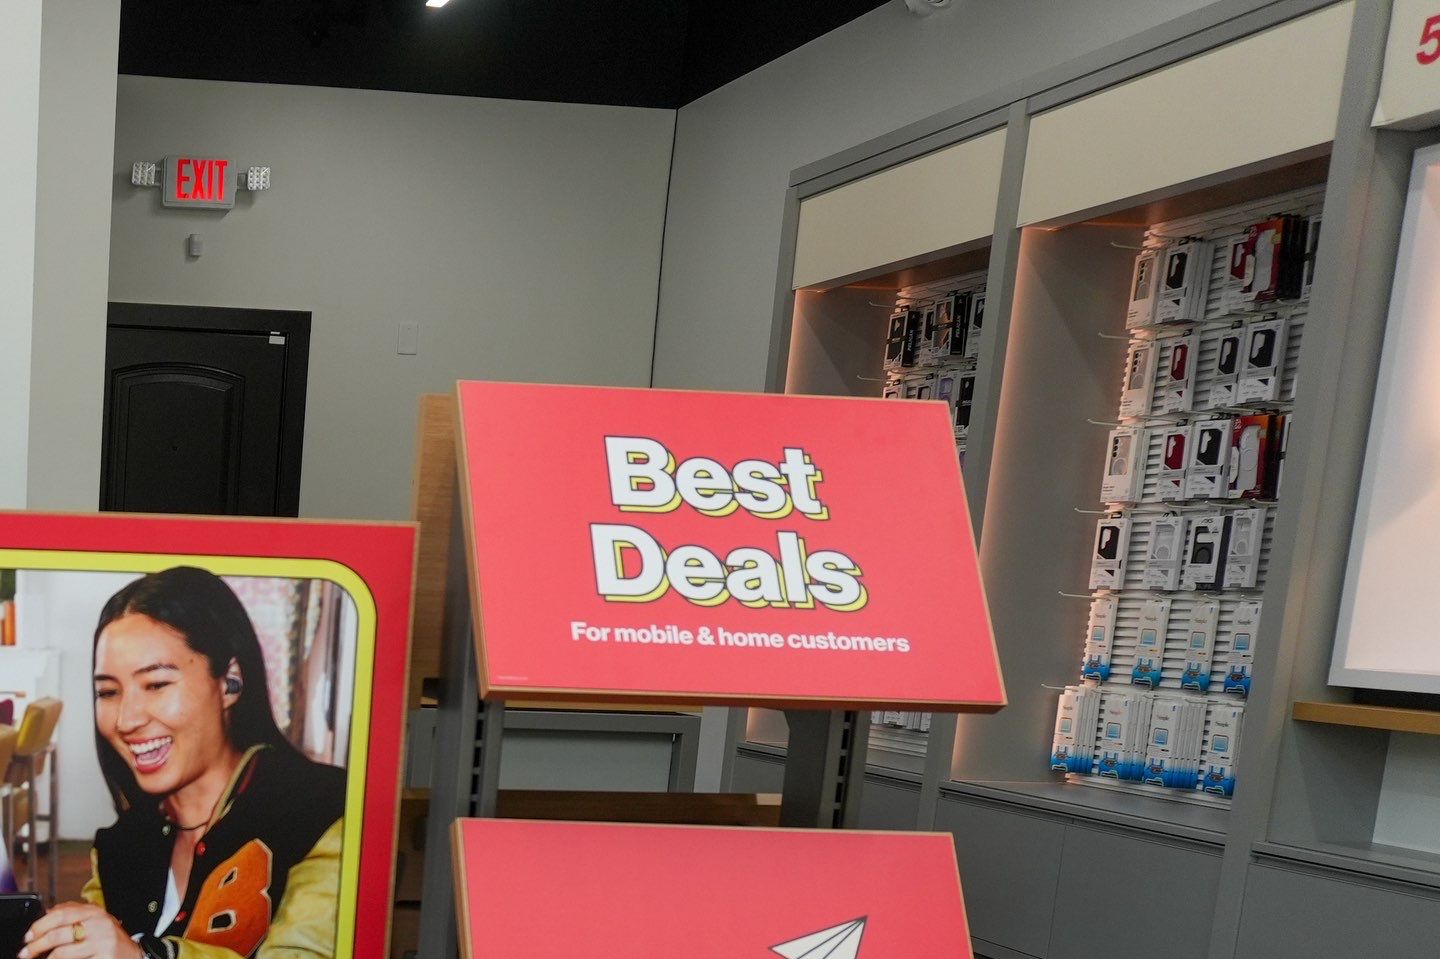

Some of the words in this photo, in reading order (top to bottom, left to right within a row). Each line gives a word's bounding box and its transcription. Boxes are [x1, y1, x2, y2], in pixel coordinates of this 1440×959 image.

[176, 159, 228, 201] EXIT
[604, 436, 830, 520] Best
[589, 523, 868, 612] Deals
[571, 622, 610, 641] For
[615, 625, 693, 645] mobile
[698, 627, 715, 645] &
[718, 627, 784, 648] home
[787, 631, 910, 652] customers
